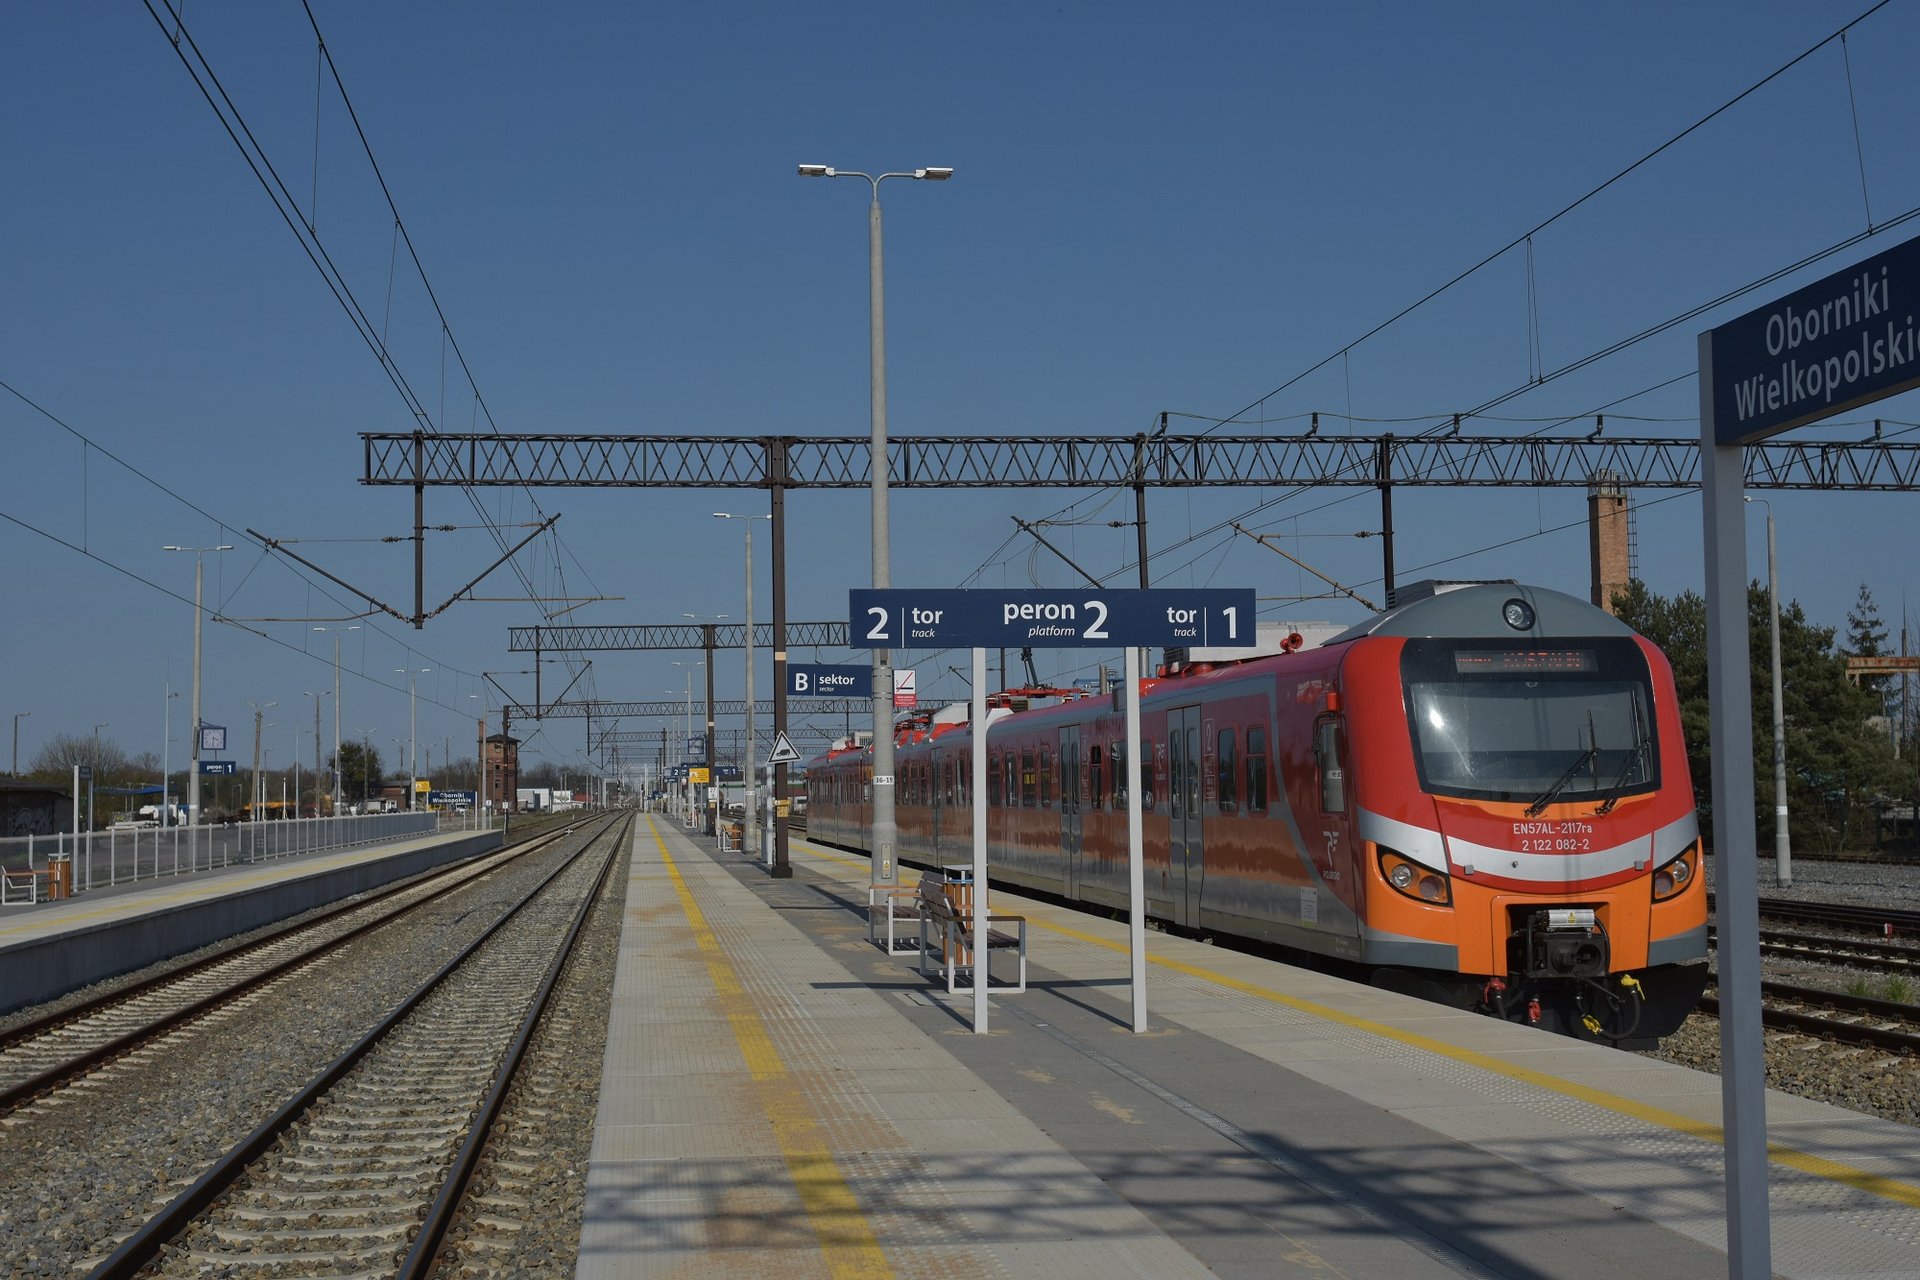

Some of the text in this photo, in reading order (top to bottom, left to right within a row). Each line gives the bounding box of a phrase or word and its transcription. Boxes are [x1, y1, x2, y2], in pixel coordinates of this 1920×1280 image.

[1765, 266, 1889, 356] Oborniki
[1734, 315, 1920, 421] Wielkopolski
[866, 606, 944, 640] 2 tor
[1004, 600, 1109, 639] peron 2
[1166, 606, 1237, 639] tor 1
[911, 628, 936, 638] track
[1028, 625, 1075, 638] platform
[1174, 627, 1197, 637] track
[795, 672, 855, 692] B sektor
[227, 765, 232, 773] 1
[673, 768, 679, 776] 2
[1513, 822, 1593, 834] EN57AL-2117ra
[1522, 838, 1590, 851] 2 122 082-2
